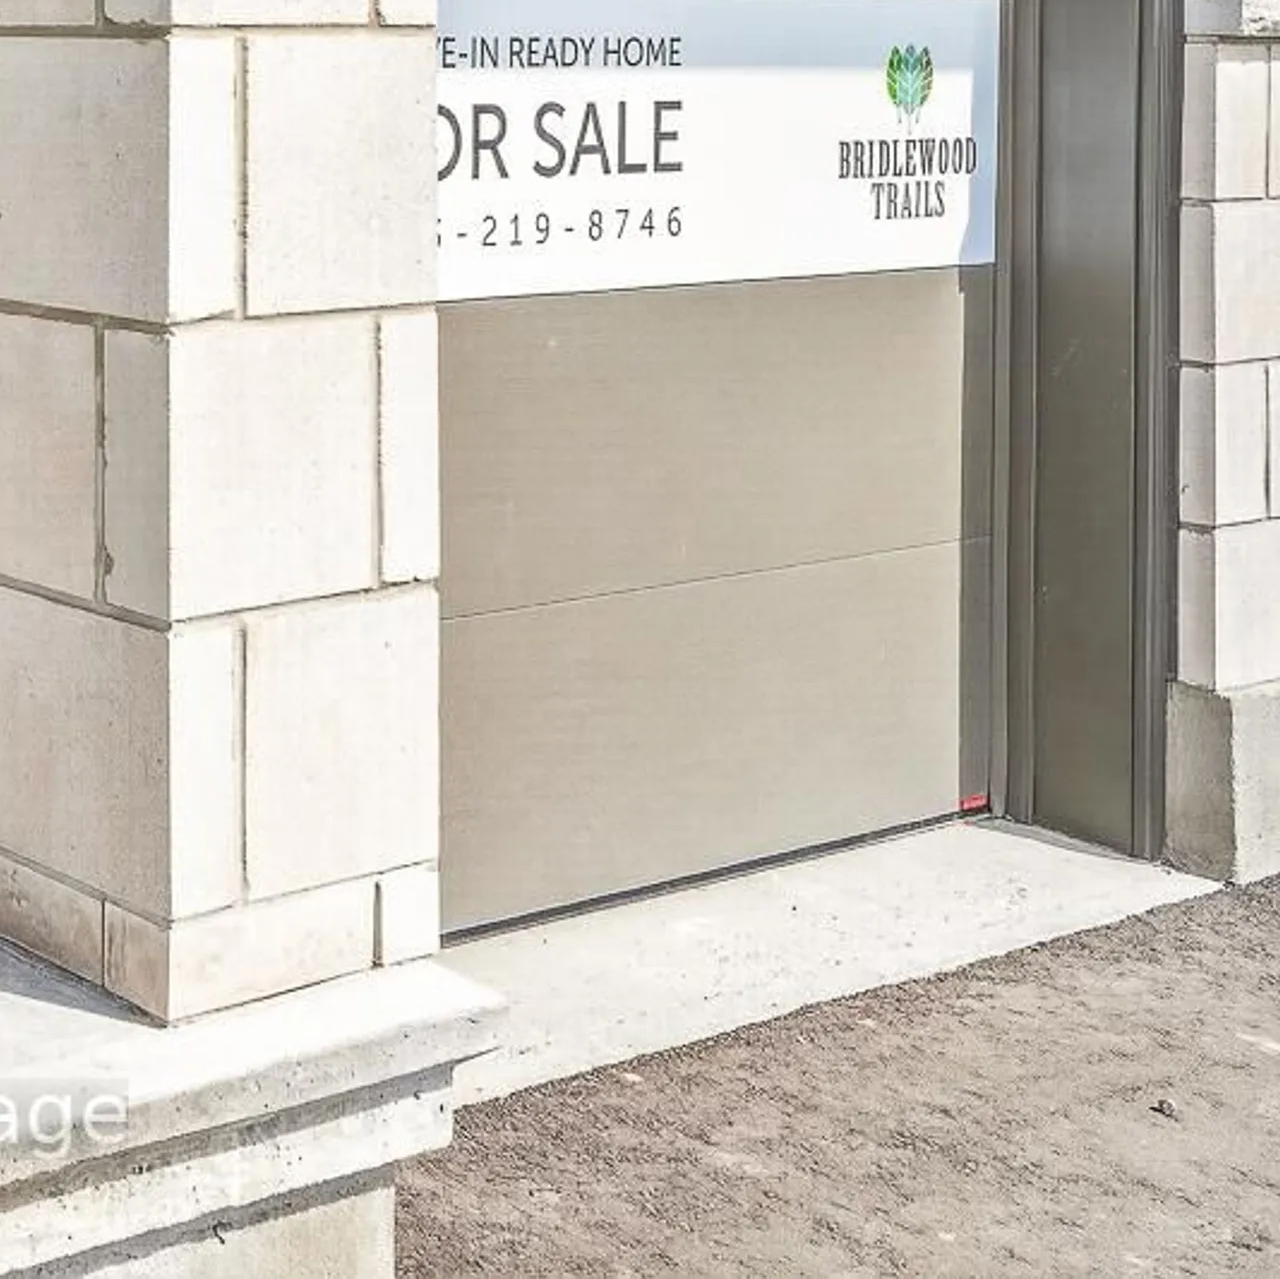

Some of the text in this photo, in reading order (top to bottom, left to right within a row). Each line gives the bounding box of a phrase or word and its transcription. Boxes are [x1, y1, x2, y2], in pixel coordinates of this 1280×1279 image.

[437, 36, 683, 69] E-IN READY HOME
[533, 100, 683, 178] SALE
[838, 136, 978, 179] BRIDLEWOOD
[870, 181, 946, 220] TRAILS
